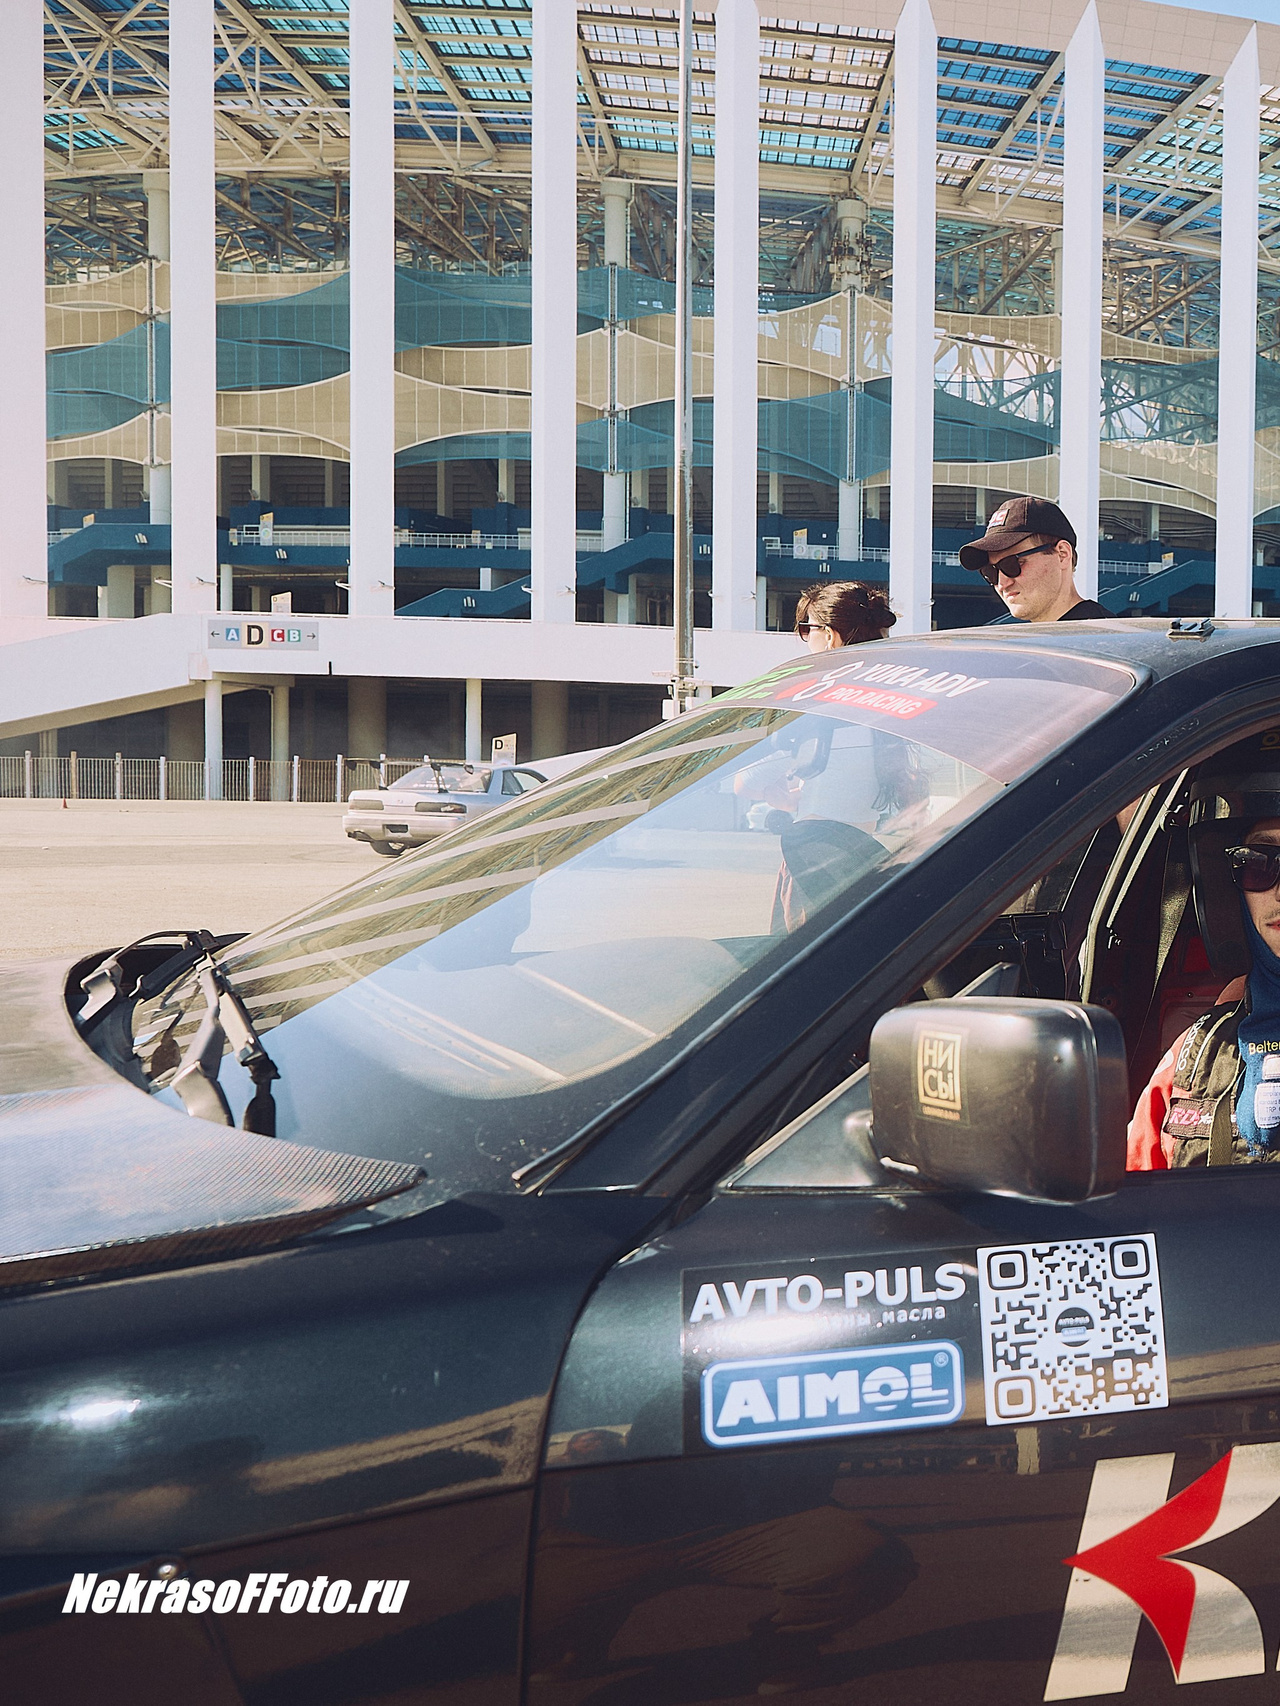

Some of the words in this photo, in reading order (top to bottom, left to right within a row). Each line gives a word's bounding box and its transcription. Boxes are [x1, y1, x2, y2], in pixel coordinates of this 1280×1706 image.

[227, 628, 239, 640] A
[247, 624, 264, 645] D
[273, 629, 283, 641] C
[289, 629, 300, 641] B
[824, 686, 858, 700] PRO
[853, 690, 922, 714] RACING
[494, 739, 503, 750] D
[689, 1262, 967, 1323] AVTO-PULS
[882, 1306, 947, 1325] масла
[716, 1362, 949, 1428] AIMOL
